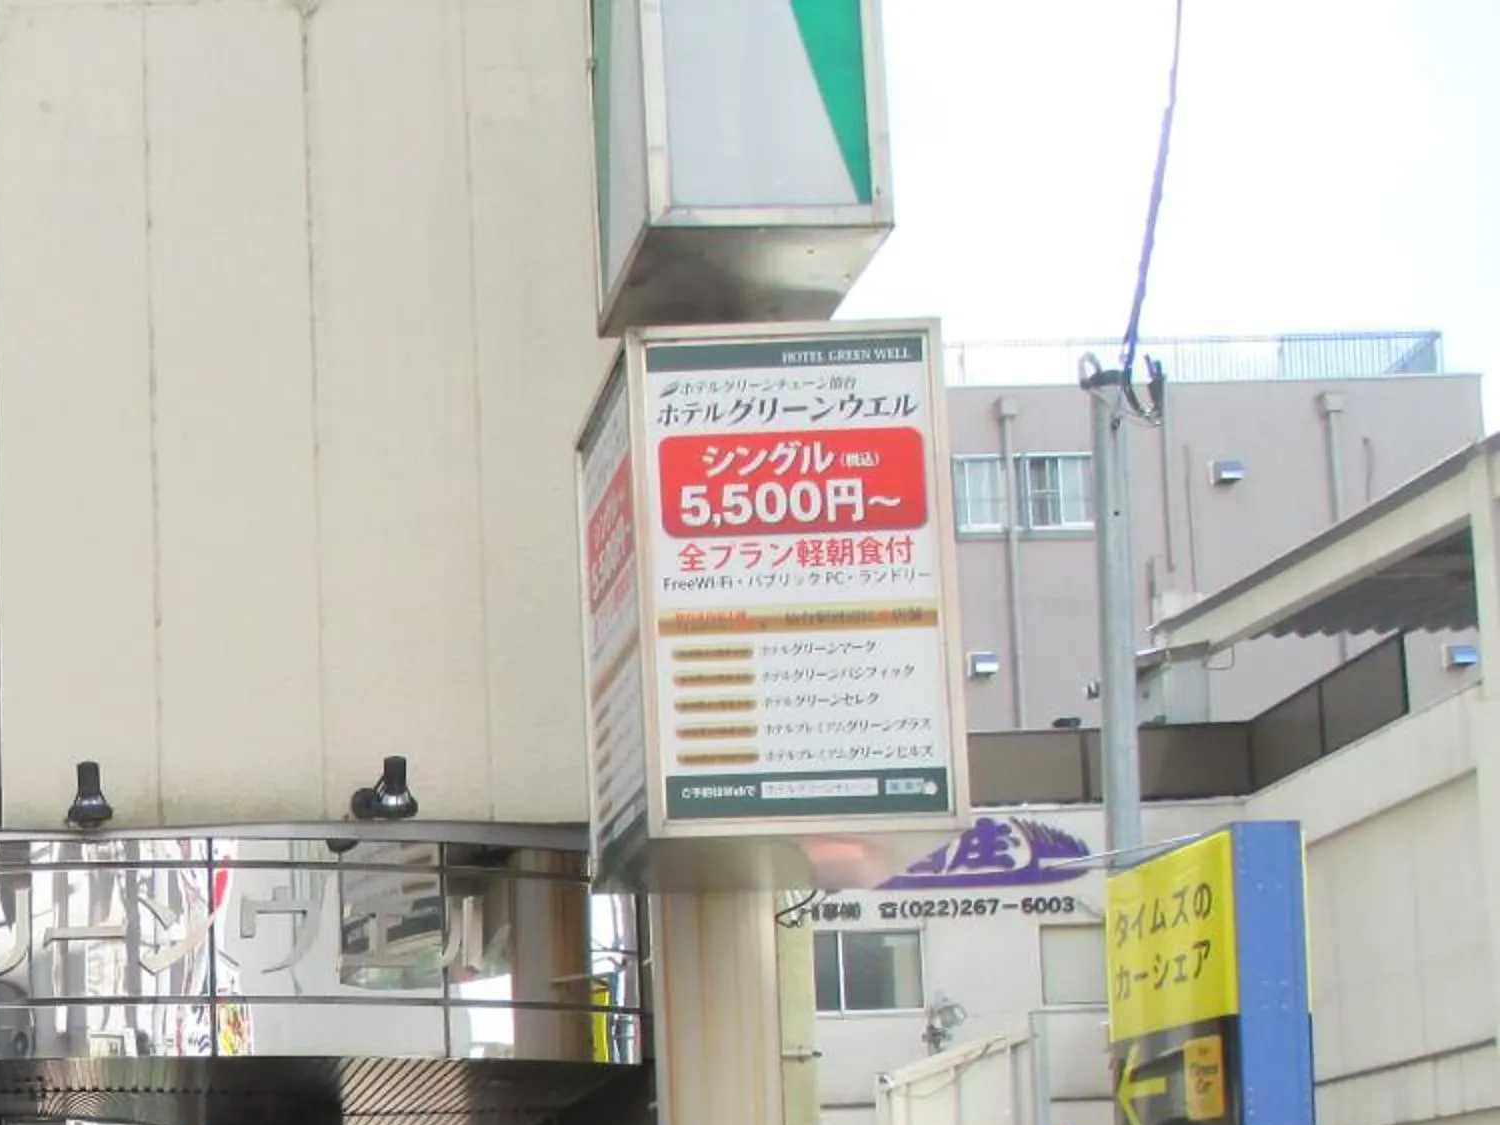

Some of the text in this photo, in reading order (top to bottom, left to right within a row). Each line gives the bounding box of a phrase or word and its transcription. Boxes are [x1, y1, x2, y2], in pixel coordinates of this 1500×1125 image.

[782, 347, 910, 364] HOTEL GREEN WELL
[657, 394, 918, 427] ホテルグリーンウエル
[701, 439, 835, 478] シングル
[678, 535, 915, 573] 全プラン軽朝食付
[1115, 939, 1211, 1000] カーシェア
